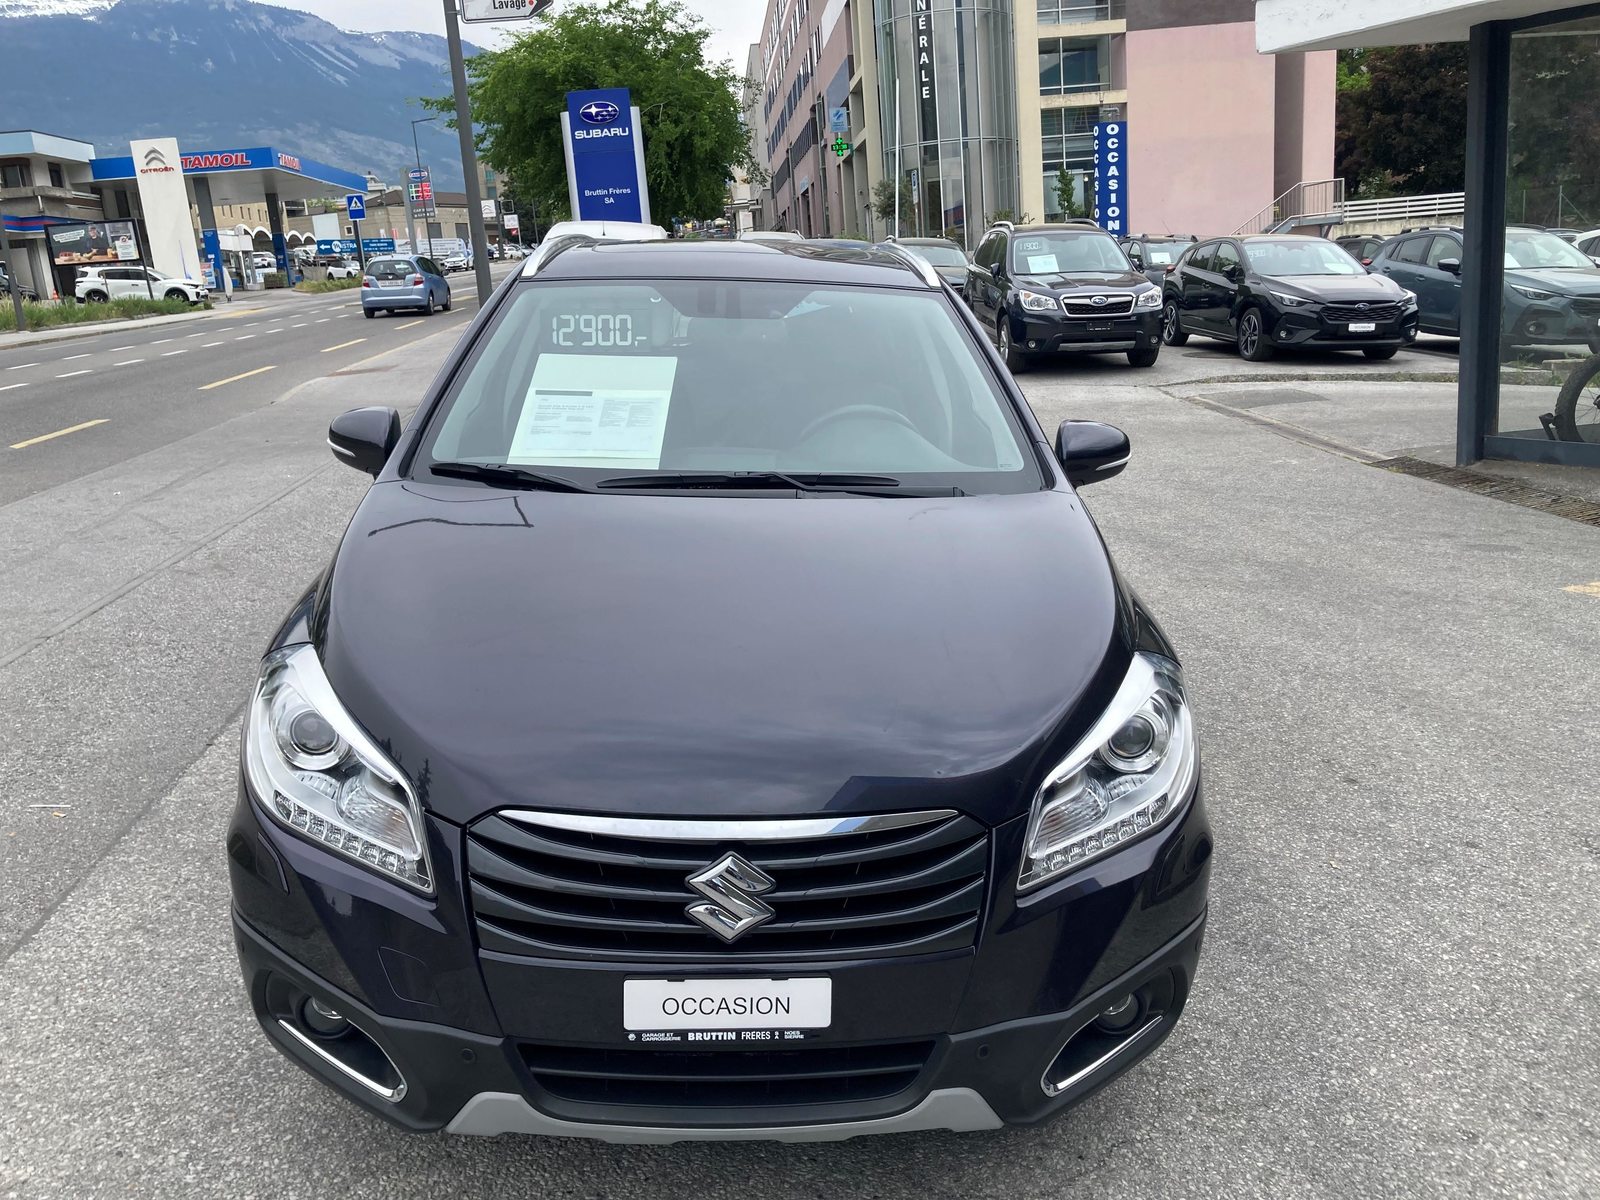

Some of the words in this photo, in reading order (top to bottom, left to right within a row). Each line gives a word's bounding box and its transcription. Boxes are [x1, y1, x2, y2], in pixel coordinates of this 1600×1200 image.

[493, 0, 526, 10] Lavage
[574, 127, 629, 139] SUBARU
[181, 153, 251, 169] TAMOIL
[584, 189, 608, 197] Bruttin
[662, 996, 791, 1016] OCCASION
[688, 1031, 736, 1041] BRUTTIN
